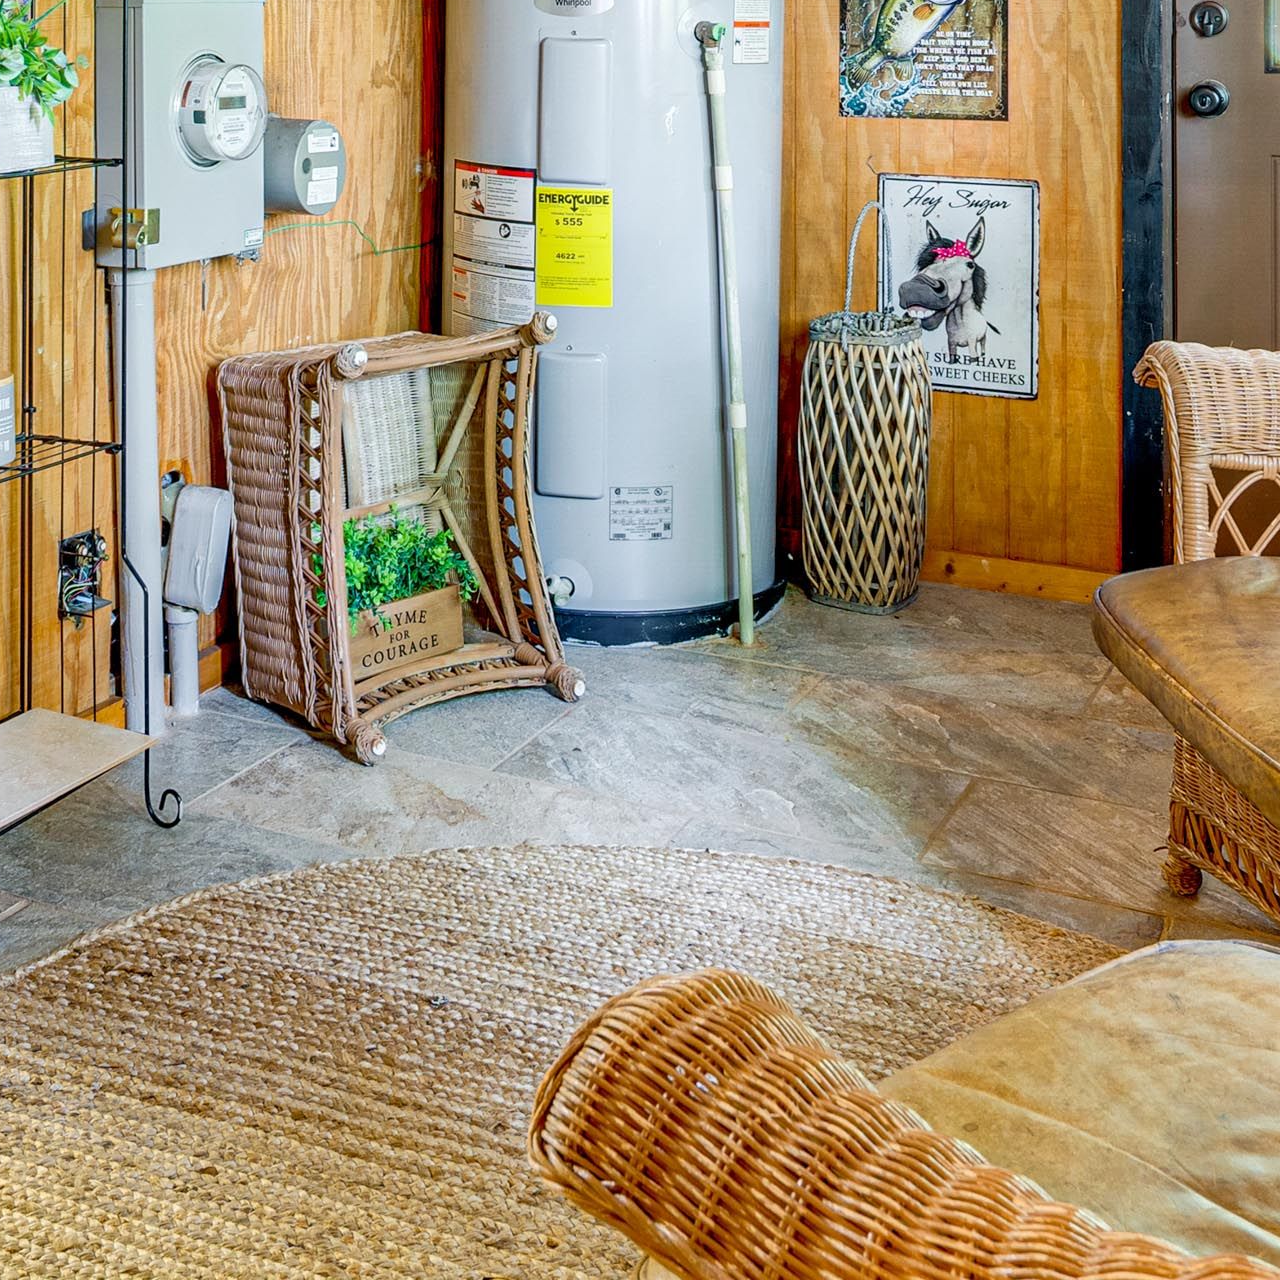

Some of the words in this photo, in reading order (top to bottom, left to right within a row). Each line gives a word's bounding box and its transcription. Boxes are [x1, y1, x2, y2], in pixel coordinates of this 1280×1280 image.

[538, 193, 610, 207] ENERGYGUIDE
[903, 184, 943, 217] Hey
[948, 189, 1011, 216] Sugar
[562, 218, 583, 226] 555
[556, 252, 576, 260] 4622
[934, 353, 971, 365] SURE
[976, 356, 1016, 370] HAVE
[928, 366, 969, 380] SWEET
[973, 370, 1025, 386] CHEEKS
[370, 610, 427, 638] THYME
[390, 630, 410, 643] FOR
[362, 634, 439, 668] COURAGE
